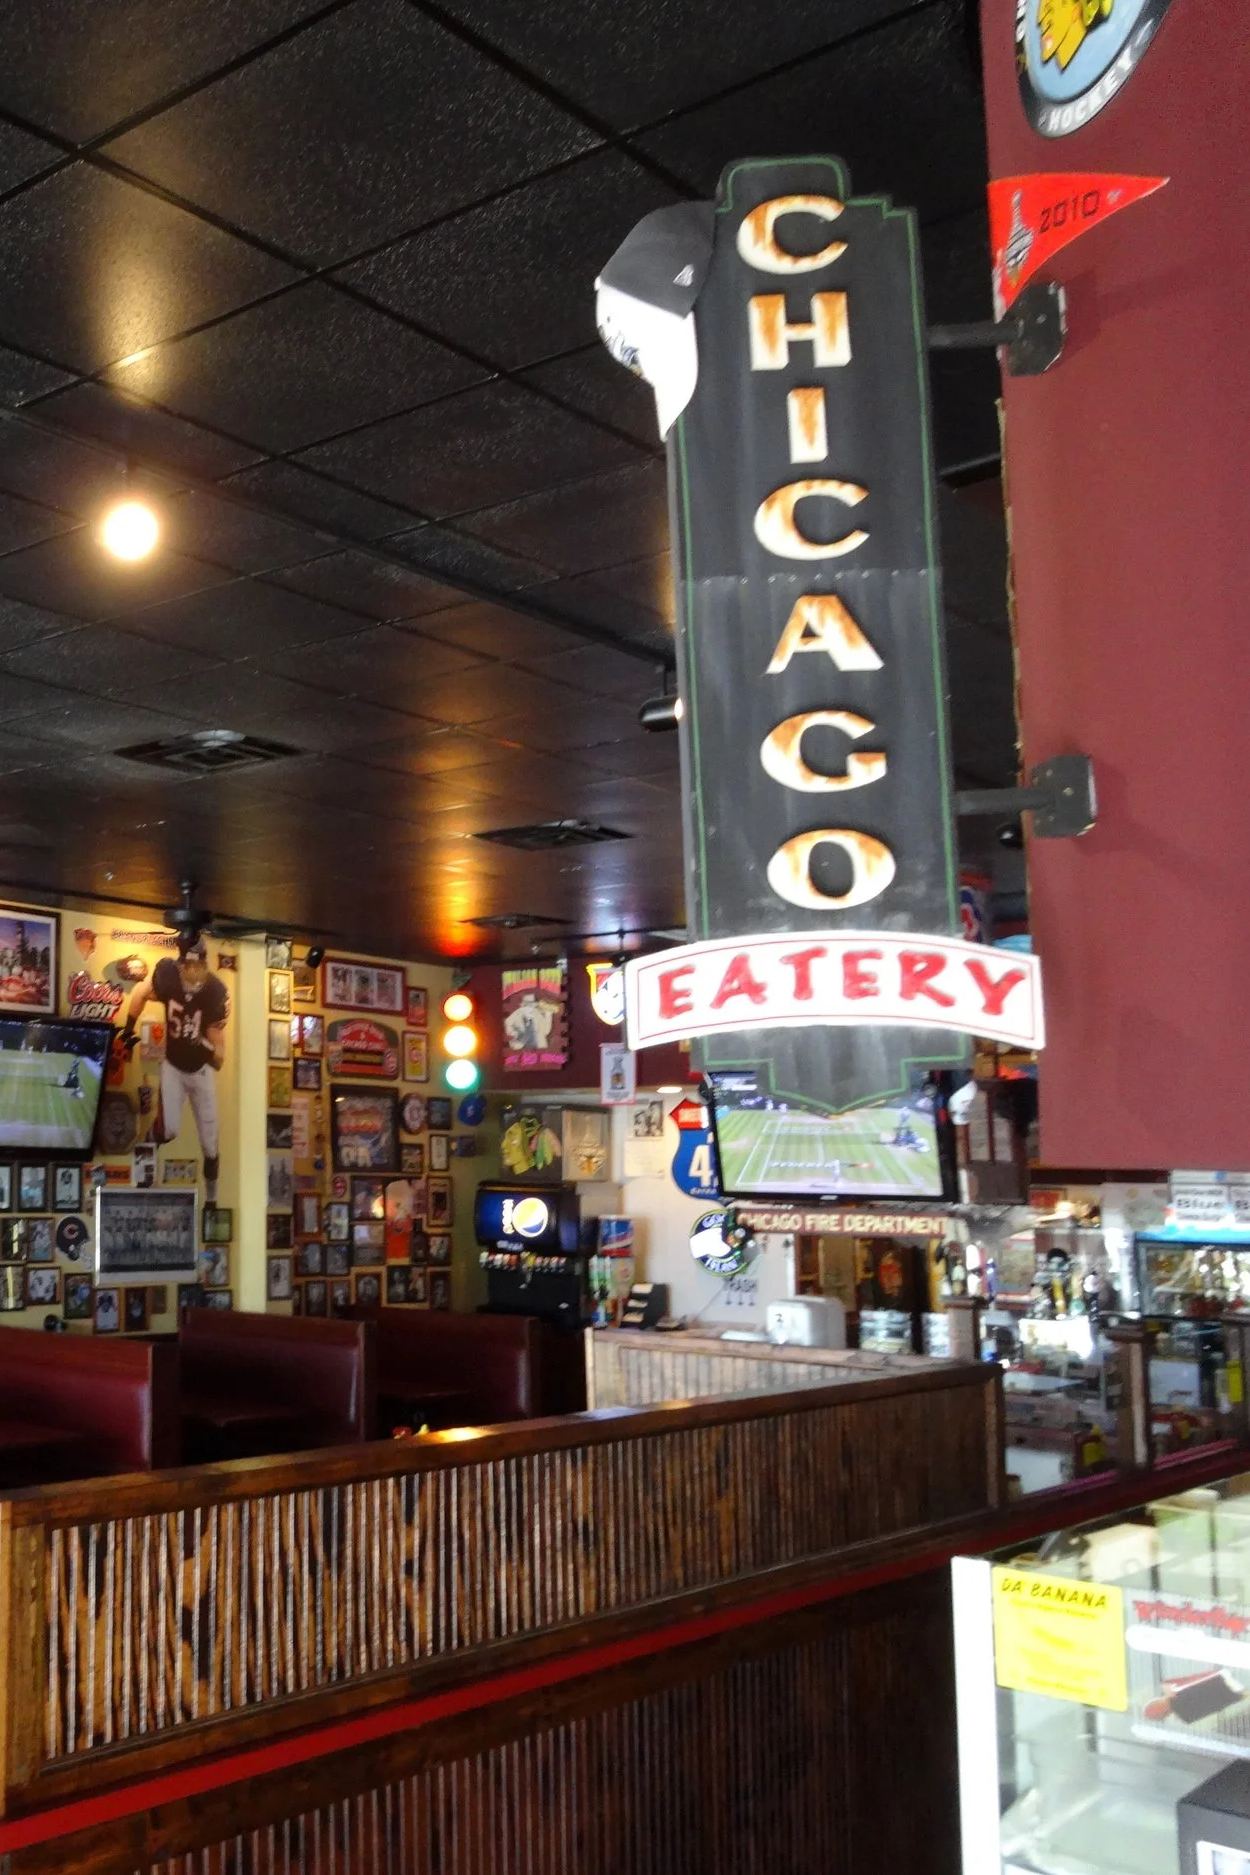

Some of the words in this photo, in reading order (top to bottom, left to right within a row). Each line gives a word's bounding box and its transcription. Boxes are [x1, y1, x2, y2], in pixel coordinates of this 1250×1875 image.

[1038, 190, 1102, 235] 2010
[737, 194, 896, 910] CHICAGO
[658, 946, 1027, 1020] EATERY
[69, 1004, 119, 1022] LIGHT
[738, 1212, 802, 1231] CHICAGO
[805, 1213, 840, 1232] FIRE
[843, 1214, 949, 1235] DEPARTMENT
[1030, 1582, 1107, 1608] BANANA
